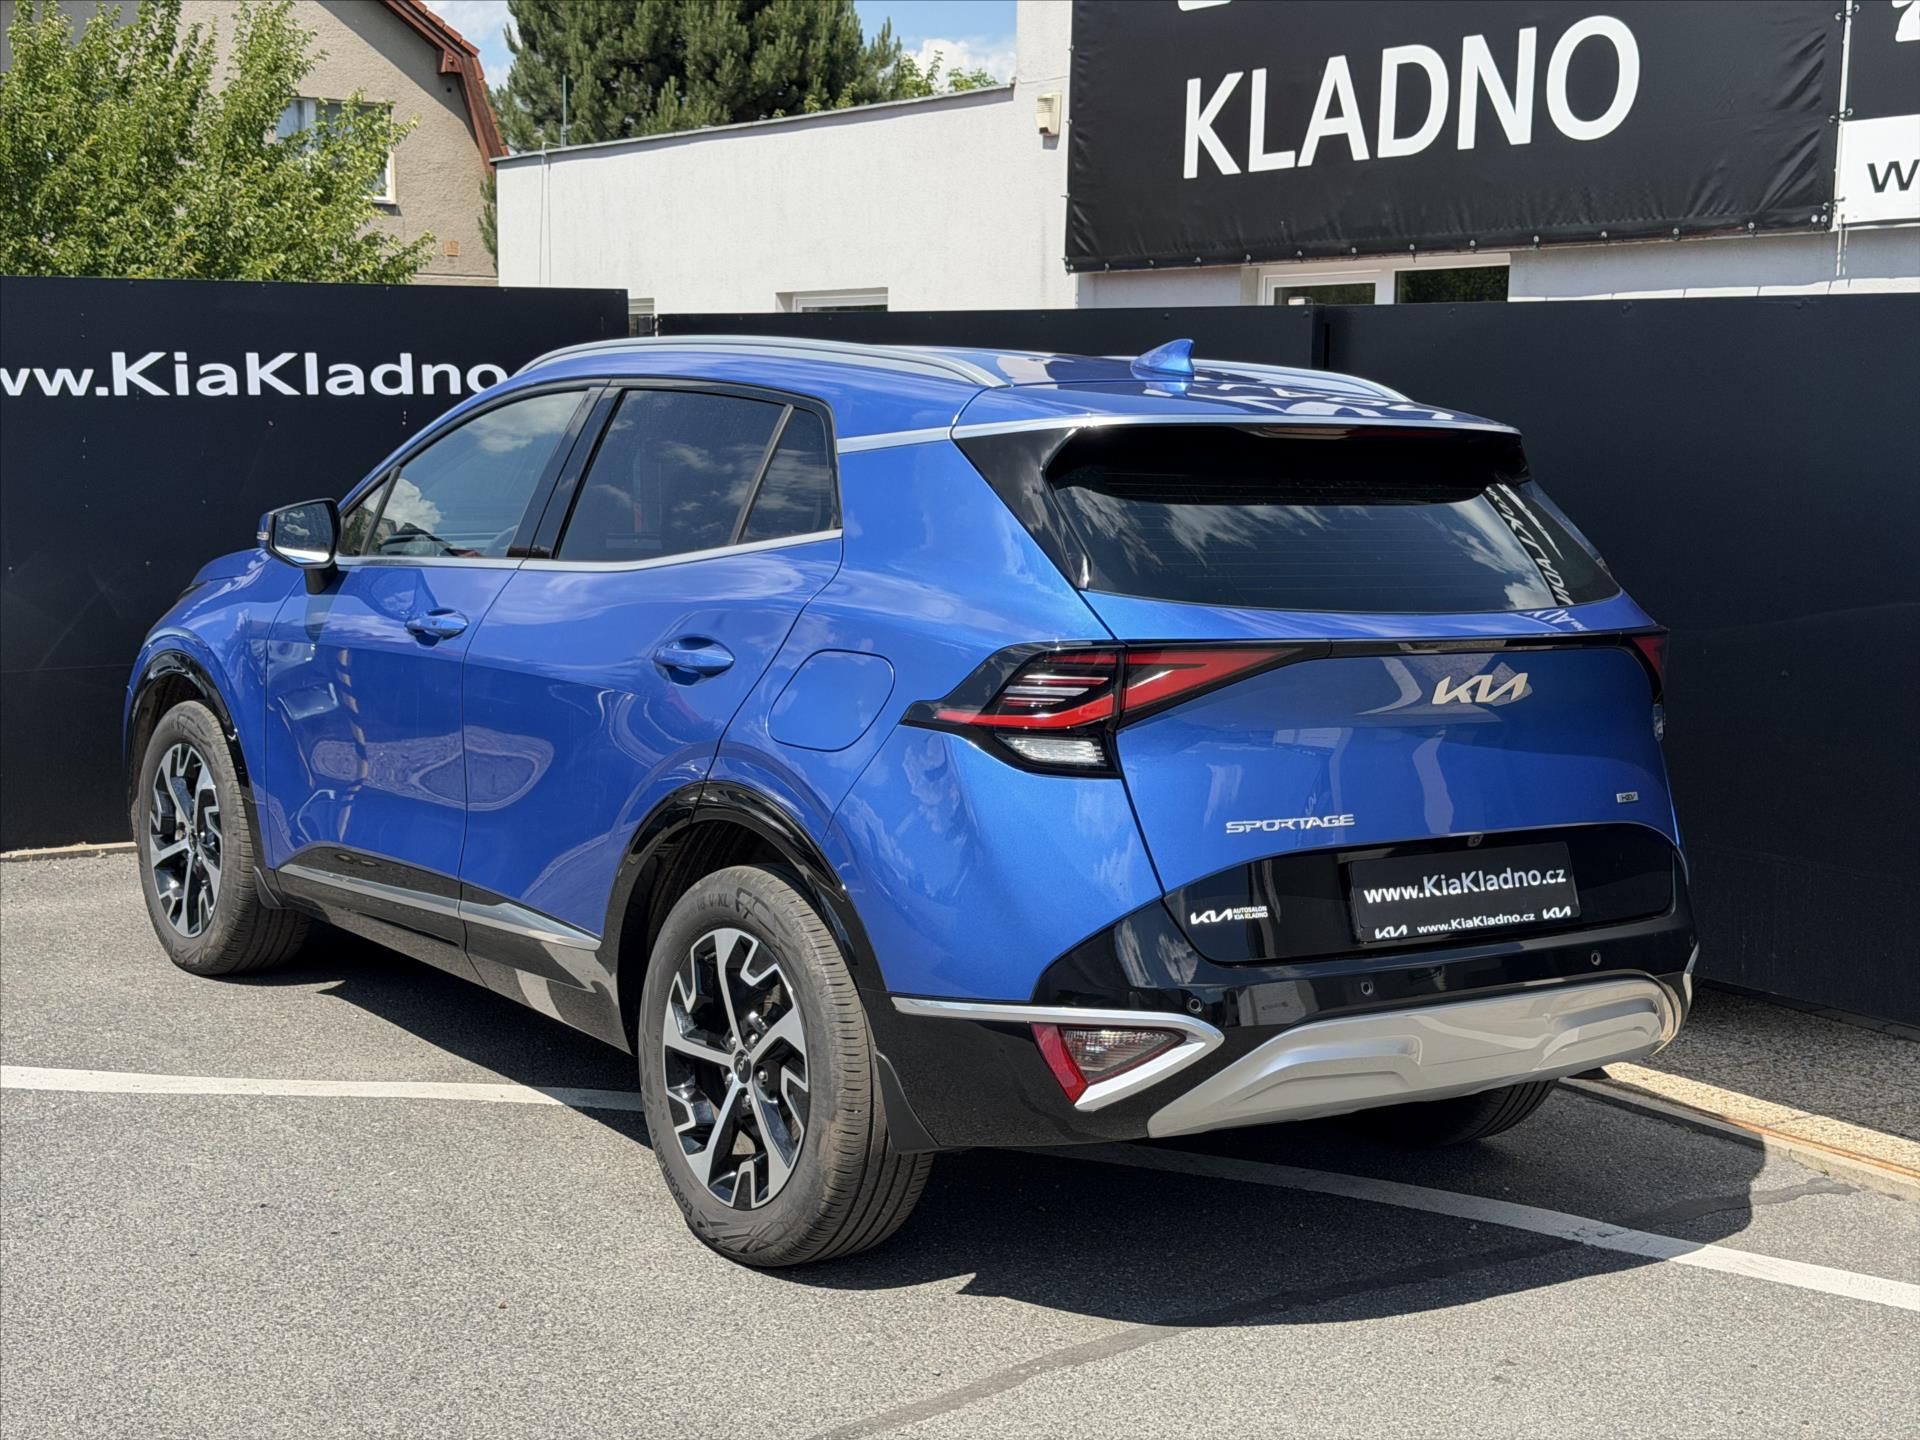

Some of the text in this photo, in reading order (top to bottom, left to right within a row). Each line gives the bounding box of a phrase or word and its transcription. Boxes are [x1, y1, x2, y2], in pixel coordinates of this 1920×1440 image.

[1183, 15, 1641, 180] KLADNO
[1225, 814, 1355, 834] SPORTAGE
[1363, 867, 1567, 904] www.KiaKladno.cz
[1417, 912, 1536, 934] www.KiaKladno.cz
